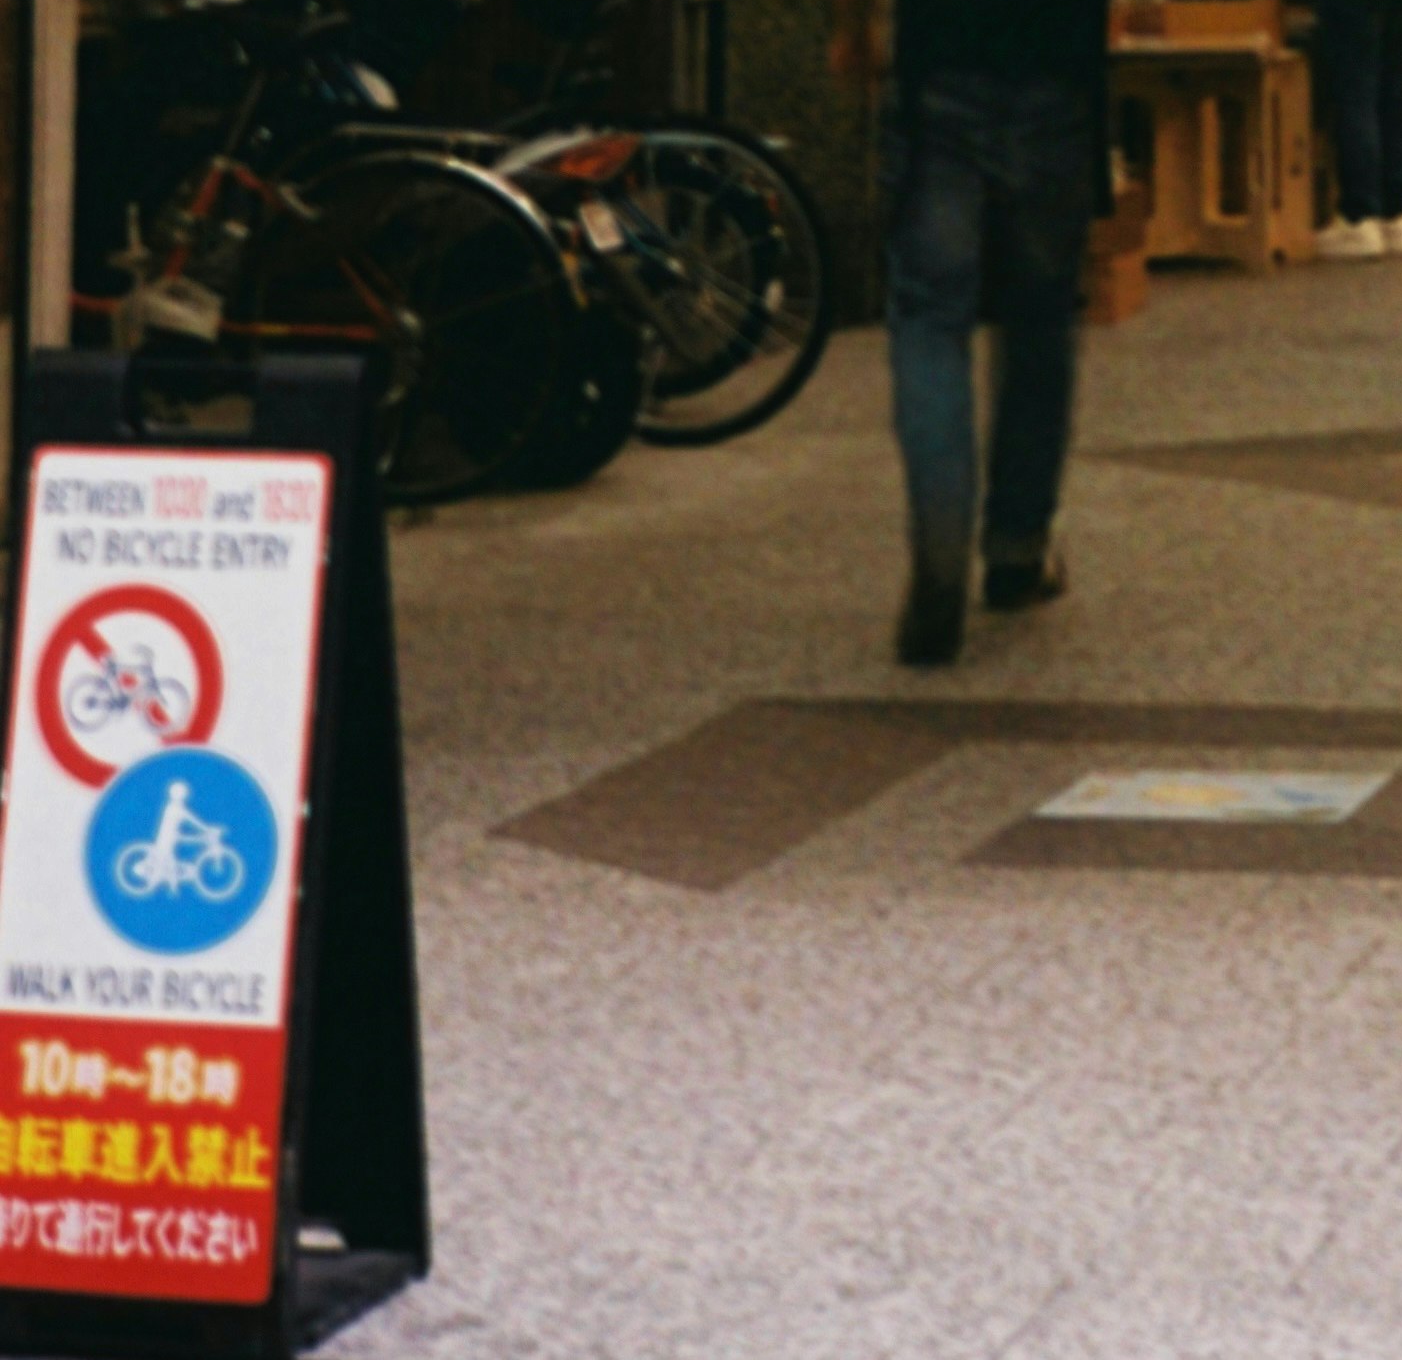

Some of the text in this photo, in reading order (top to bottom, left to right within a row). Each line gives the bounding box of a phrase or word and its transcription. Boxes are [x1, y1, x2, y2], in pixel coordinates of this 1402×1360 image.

[43, 478, 145, 518] BETWEEN
[212, 490, 255, 523] and
[57, 527, 292, 573] NO BICYCLE ENTRY
[7, 962, 266, 1015] WALK YOUR BICYCLE
